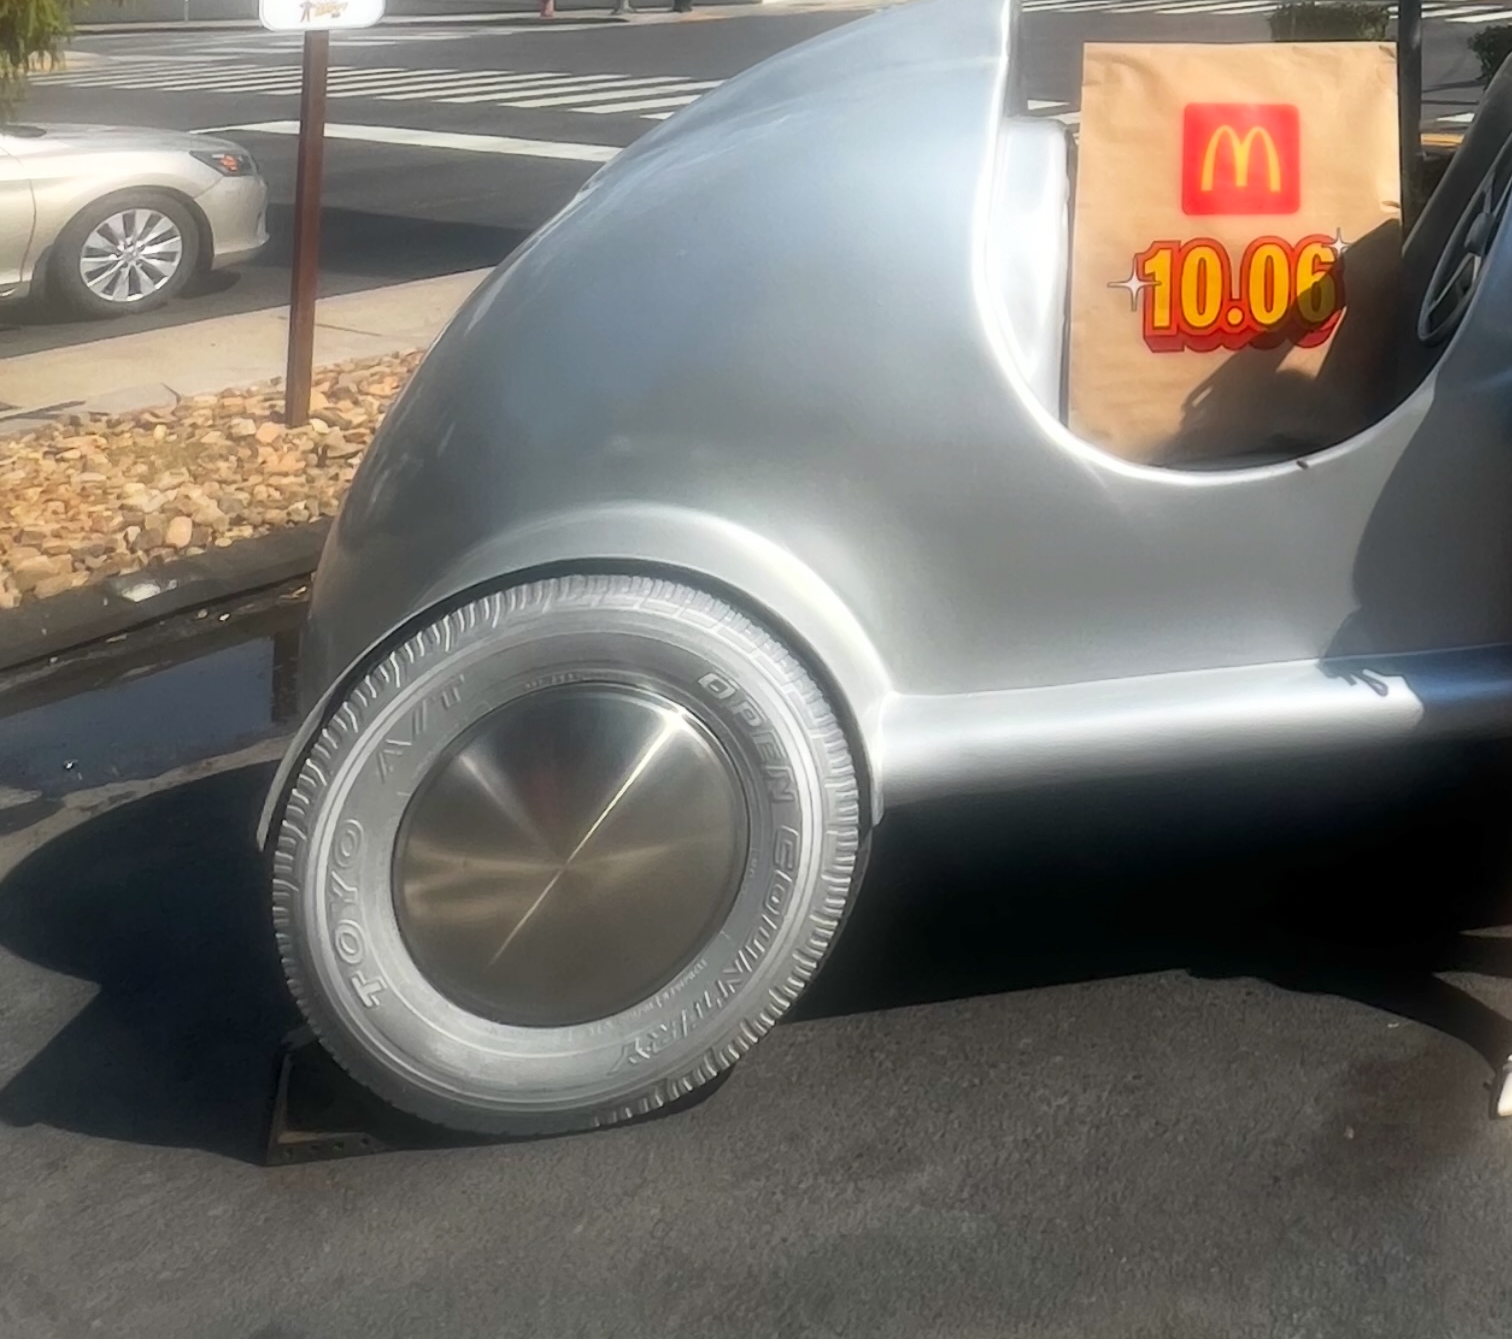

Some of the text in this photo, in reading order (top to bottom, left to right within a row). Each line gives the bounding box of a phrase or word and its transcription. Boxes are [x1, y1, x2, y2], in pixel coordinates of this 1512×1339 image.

[1140, 237, 1341, 339] 10.06
[697, 670, 799, 806] OPEN
[329, 817, 388, 1009] TOYO
